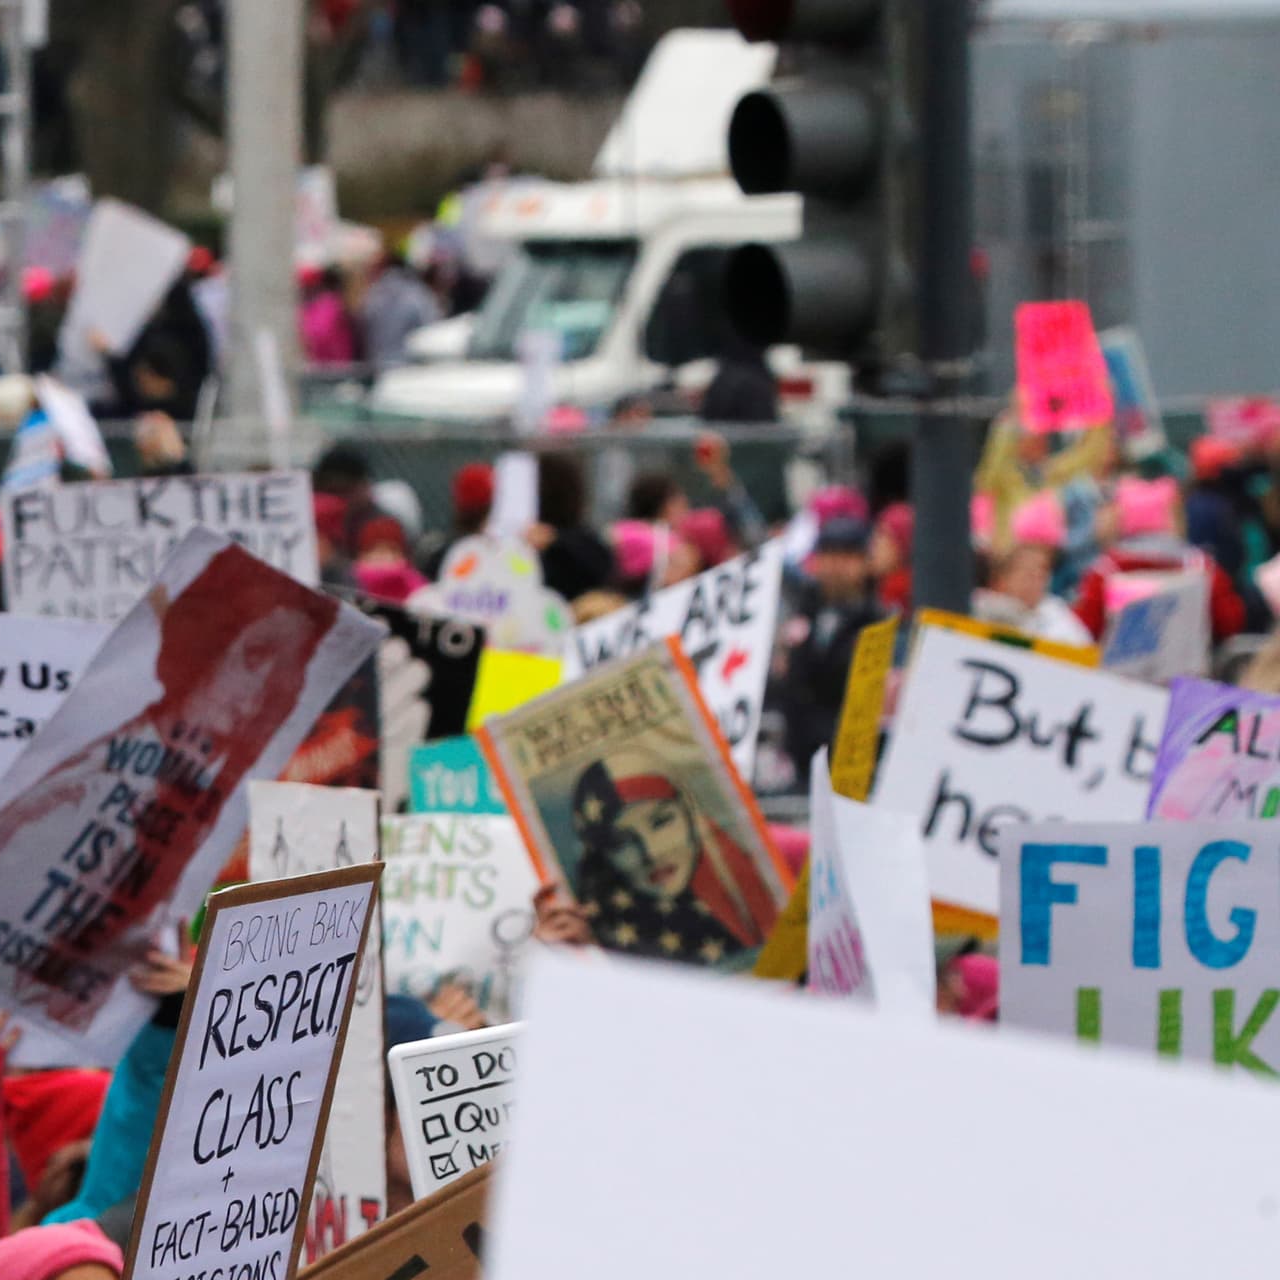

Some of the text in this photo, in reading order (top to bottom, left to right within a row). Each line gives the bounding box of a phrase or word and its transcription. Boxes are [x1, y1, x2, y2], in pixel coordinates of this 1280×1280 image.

[12, 476, 297, 540] FUCK THE
[19, 661, 75, 694] Us
[954, 658, 1107, 792] But,
[61, 820, 117, 873] IS
[222, 896, 365, 972] BRING BACK
[1019, 839, 1280, 971] FIG
[198, 951, 356, 1072] RESPECT,
[415, 1063, 459, 1092] TO
[191, 1070, 302, 1167] CLASS
[149, 1187, 300, 1270] FACT-BASED
